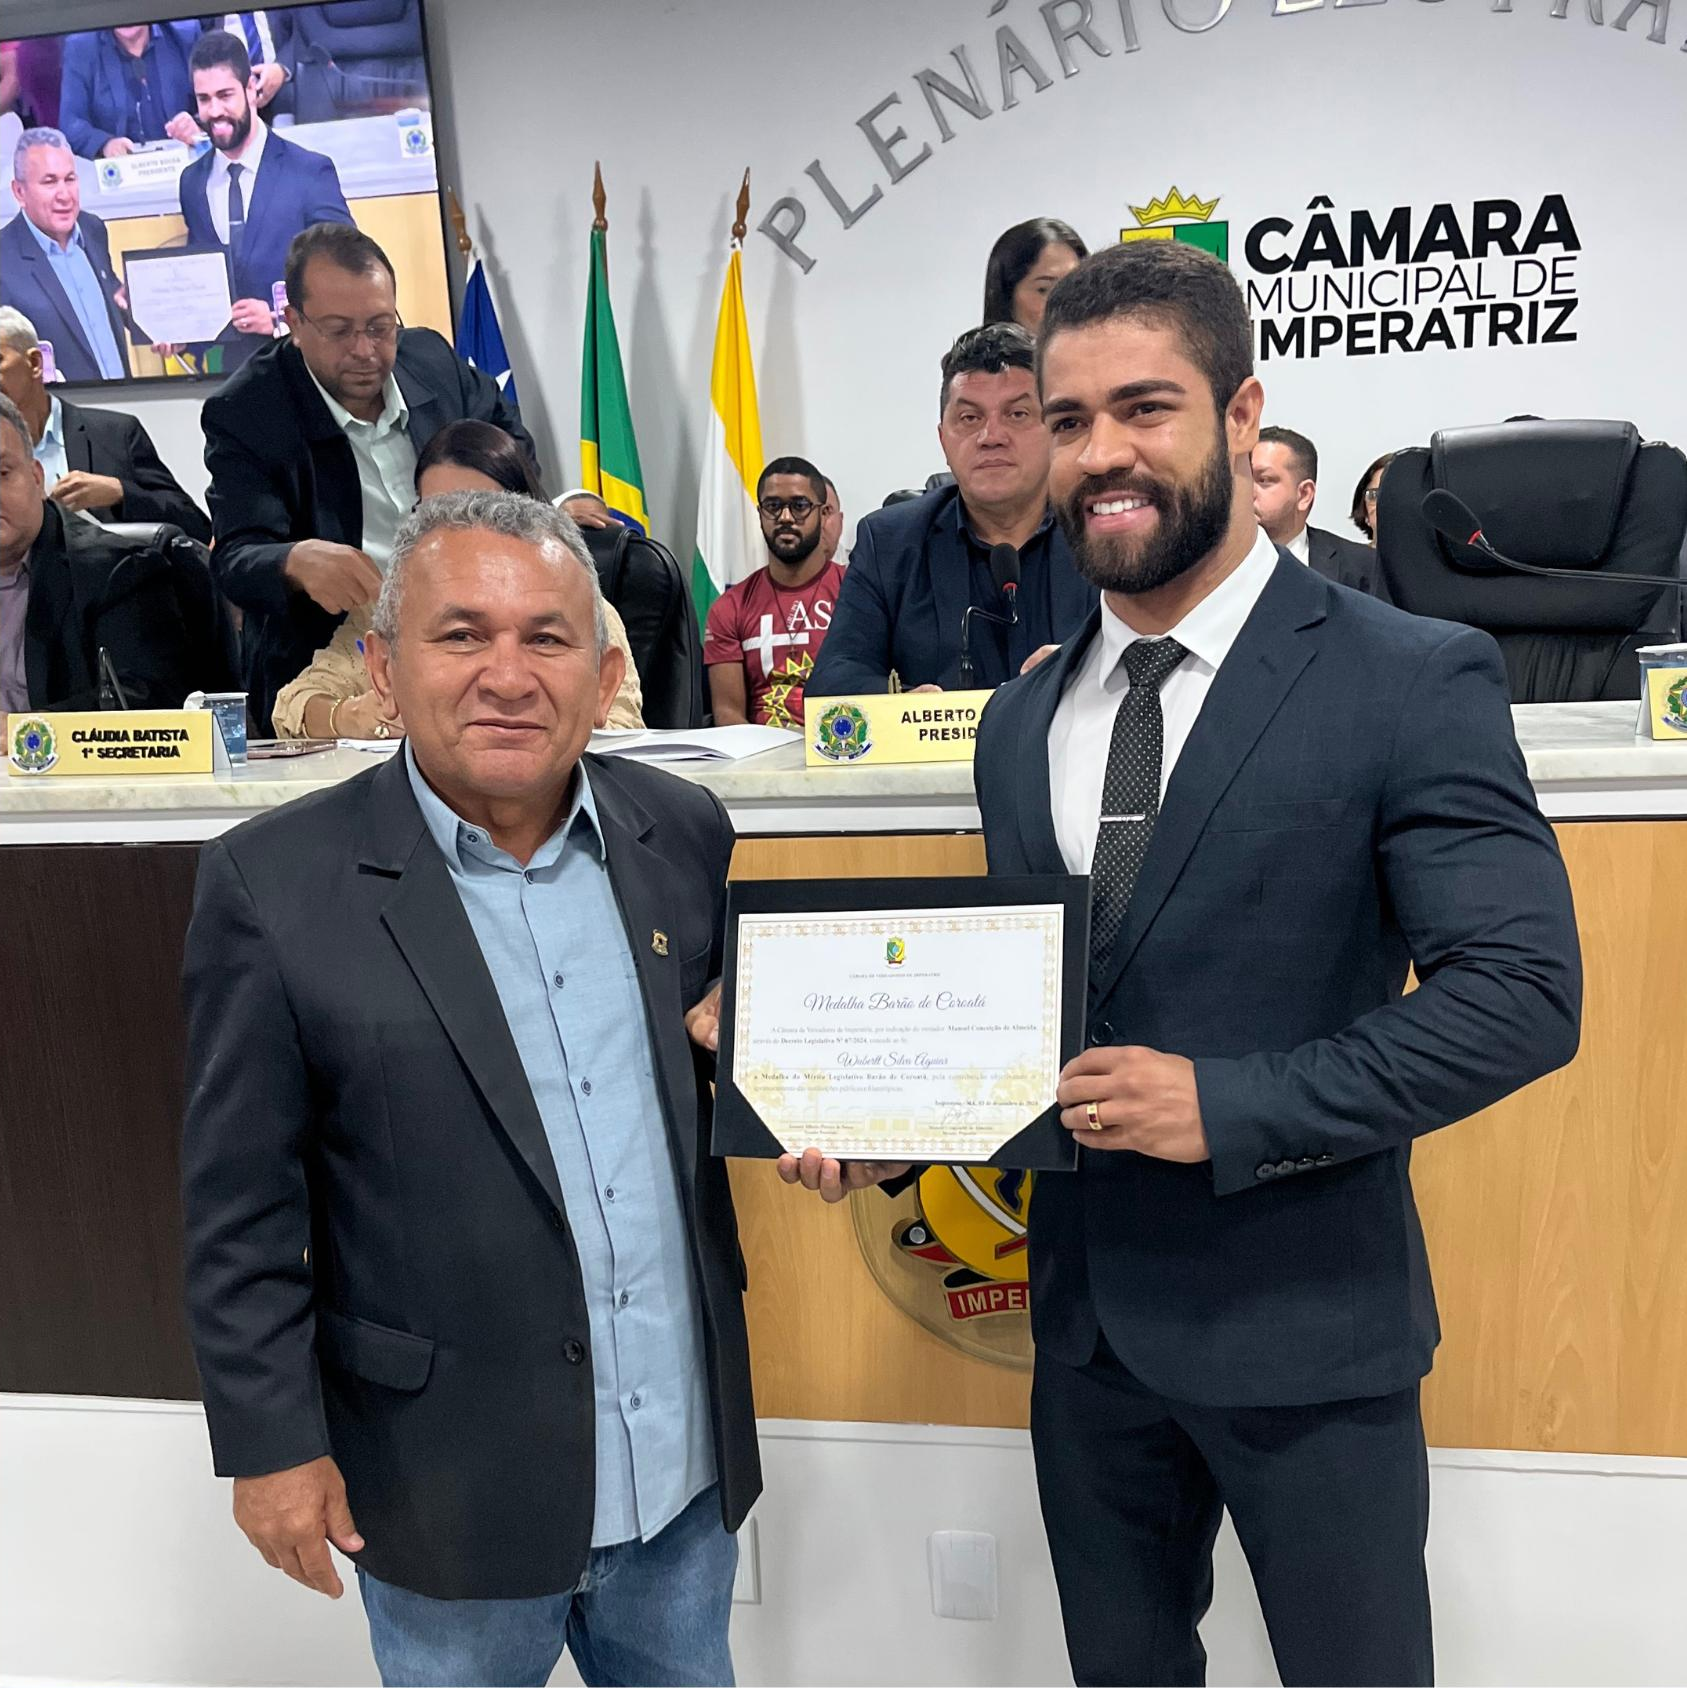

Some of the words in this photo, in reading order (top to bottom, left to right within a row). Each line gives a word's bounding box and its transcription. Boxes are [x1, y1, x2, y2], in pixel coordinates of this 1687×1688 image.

[1245, 195, 1582, 274] CÂMARA
[1248, 263, 1496, 314] MUNICIPAL
[1512, 256, 1577, 298] DE
[901, 709, 976, 724] ALBERTO
[72, 728, 128, 743] CLÁUDIA
[133, 729, 189, 742] BATISTA
[920, 727, 977, 741] PRESID
[98, 746, 180, 759] SECRETARIA
[803, 993, 864, 1012] Medalha
[869, 993, 914, 1010] Barão
[918, 995, 931, 1009] de
[936, 991, 987, 1010] Coroatá
[957, 1289, 1030, 1314] IMPE
